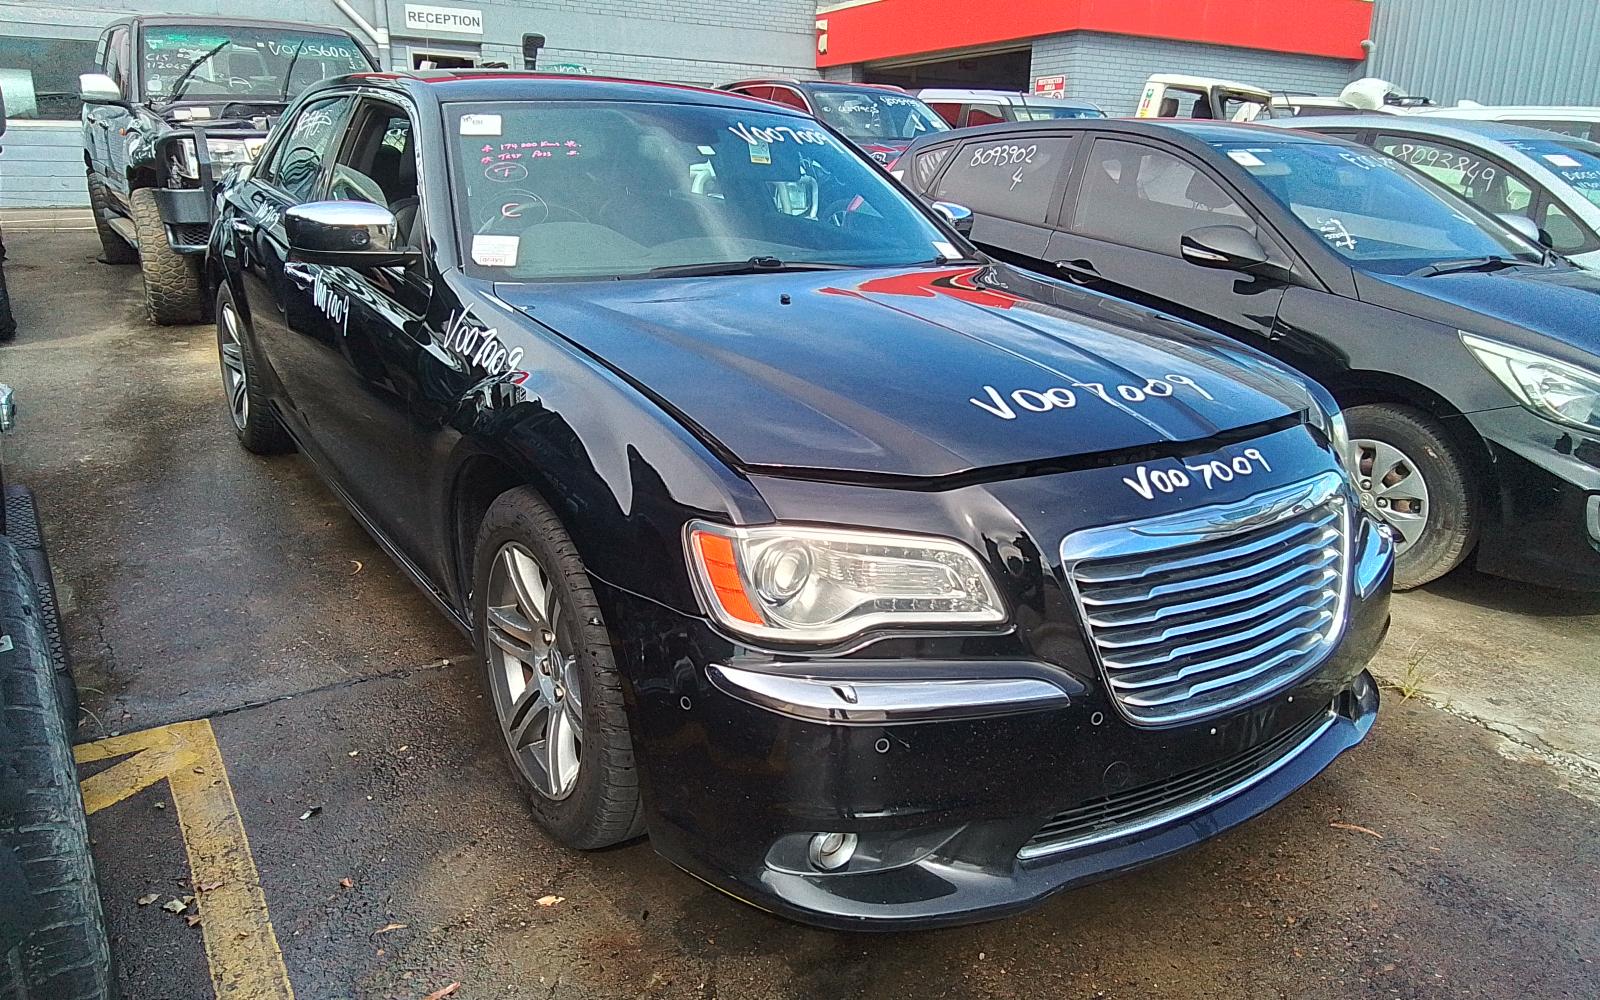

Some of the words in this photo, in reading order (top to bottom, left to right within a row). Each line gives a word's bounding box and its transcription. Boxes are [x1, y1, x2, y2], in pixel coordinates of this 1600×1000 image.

[408, 11, 481, 27] RECEPTION
[970, 144, 1037, 168] 8093902
[1009, 166, 1024, 192] 4
[1396, 143, 1496, 193] 8093849
[313, 269, 350, 337] V007009
[443, 302, 524, 380] V007009
[969, 373, 1214, 420] V007009
[1122, 448, 1272, 500] V007009
